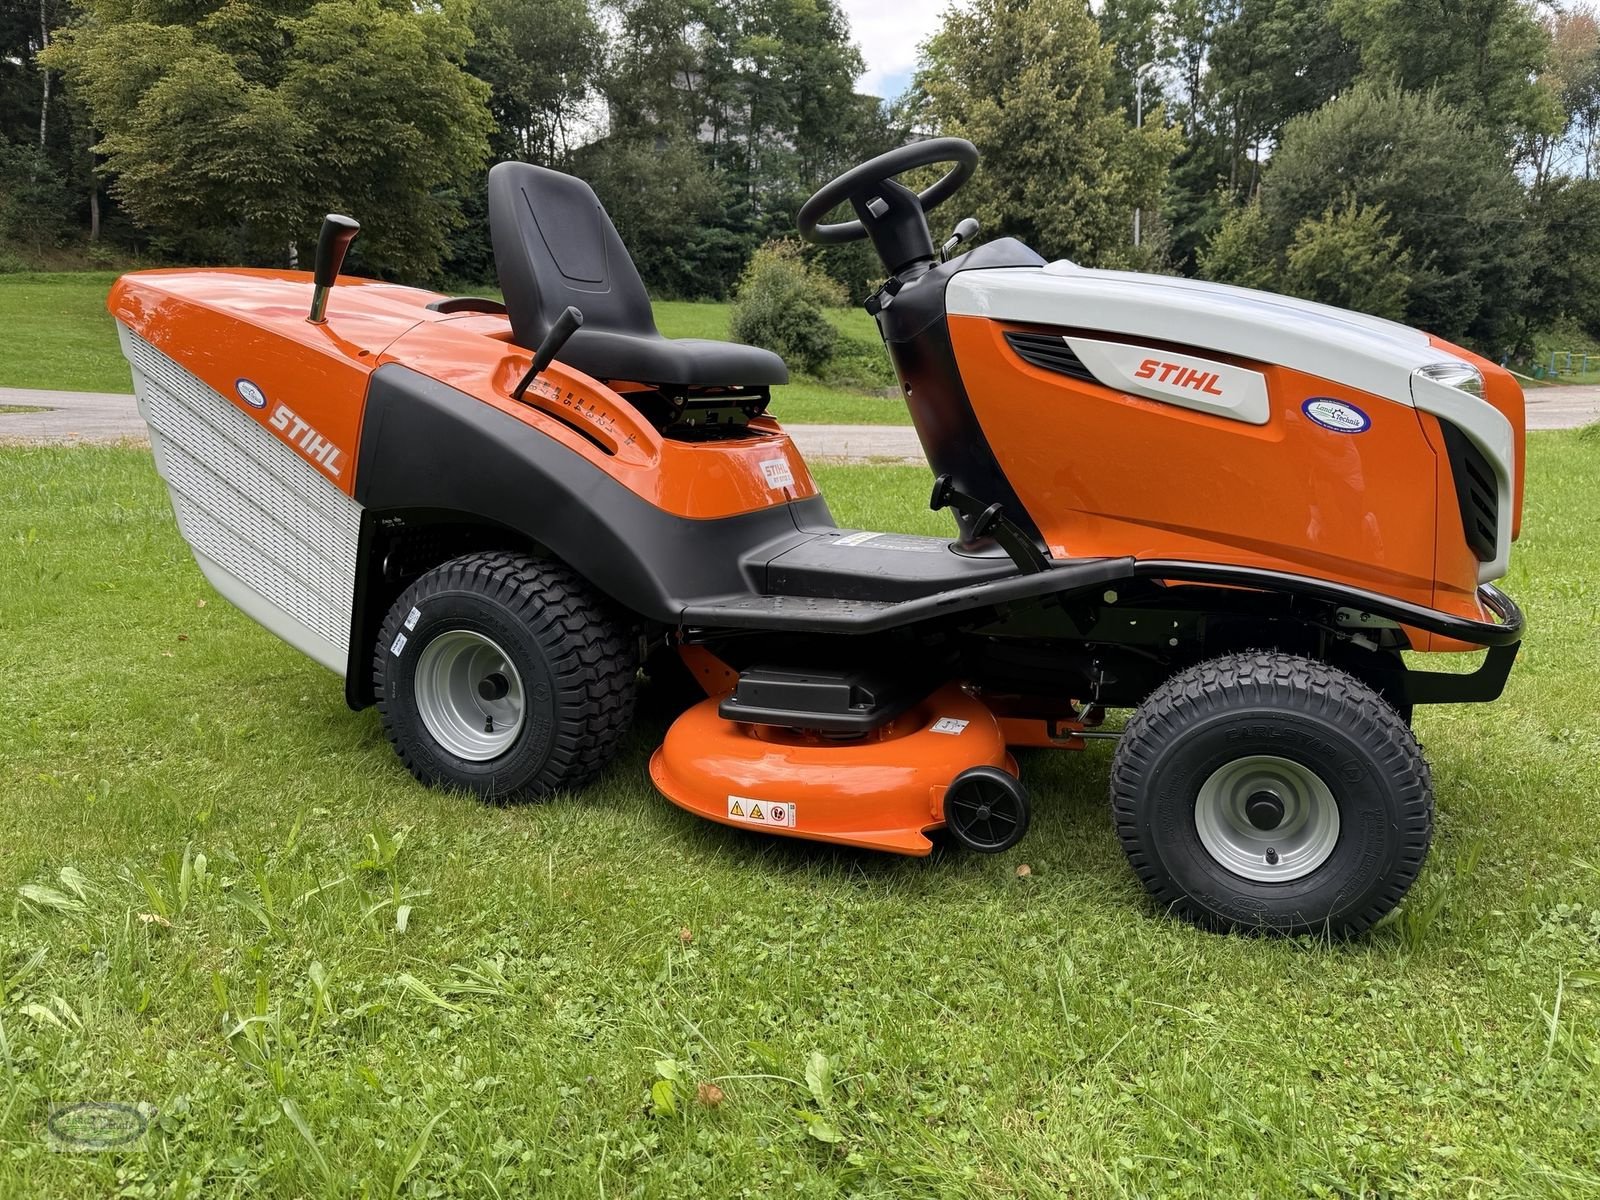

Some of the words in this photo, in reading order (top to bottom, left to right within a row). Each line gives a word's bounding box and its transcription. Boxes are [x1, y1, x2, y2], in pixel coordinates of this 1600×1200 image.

[1134, 359, 1223, 395] STIHL
[563, 399, 572, 407] 5
[574, 404, 582, 412] 4
[585, 411, 594, 419] 3
[1316, 403, 1334, 413] Land
[1336, 413, 1361, 427] Technik
[268, 404, 341, 477] STIHL
[765, 463, 788, 477] STIHL
